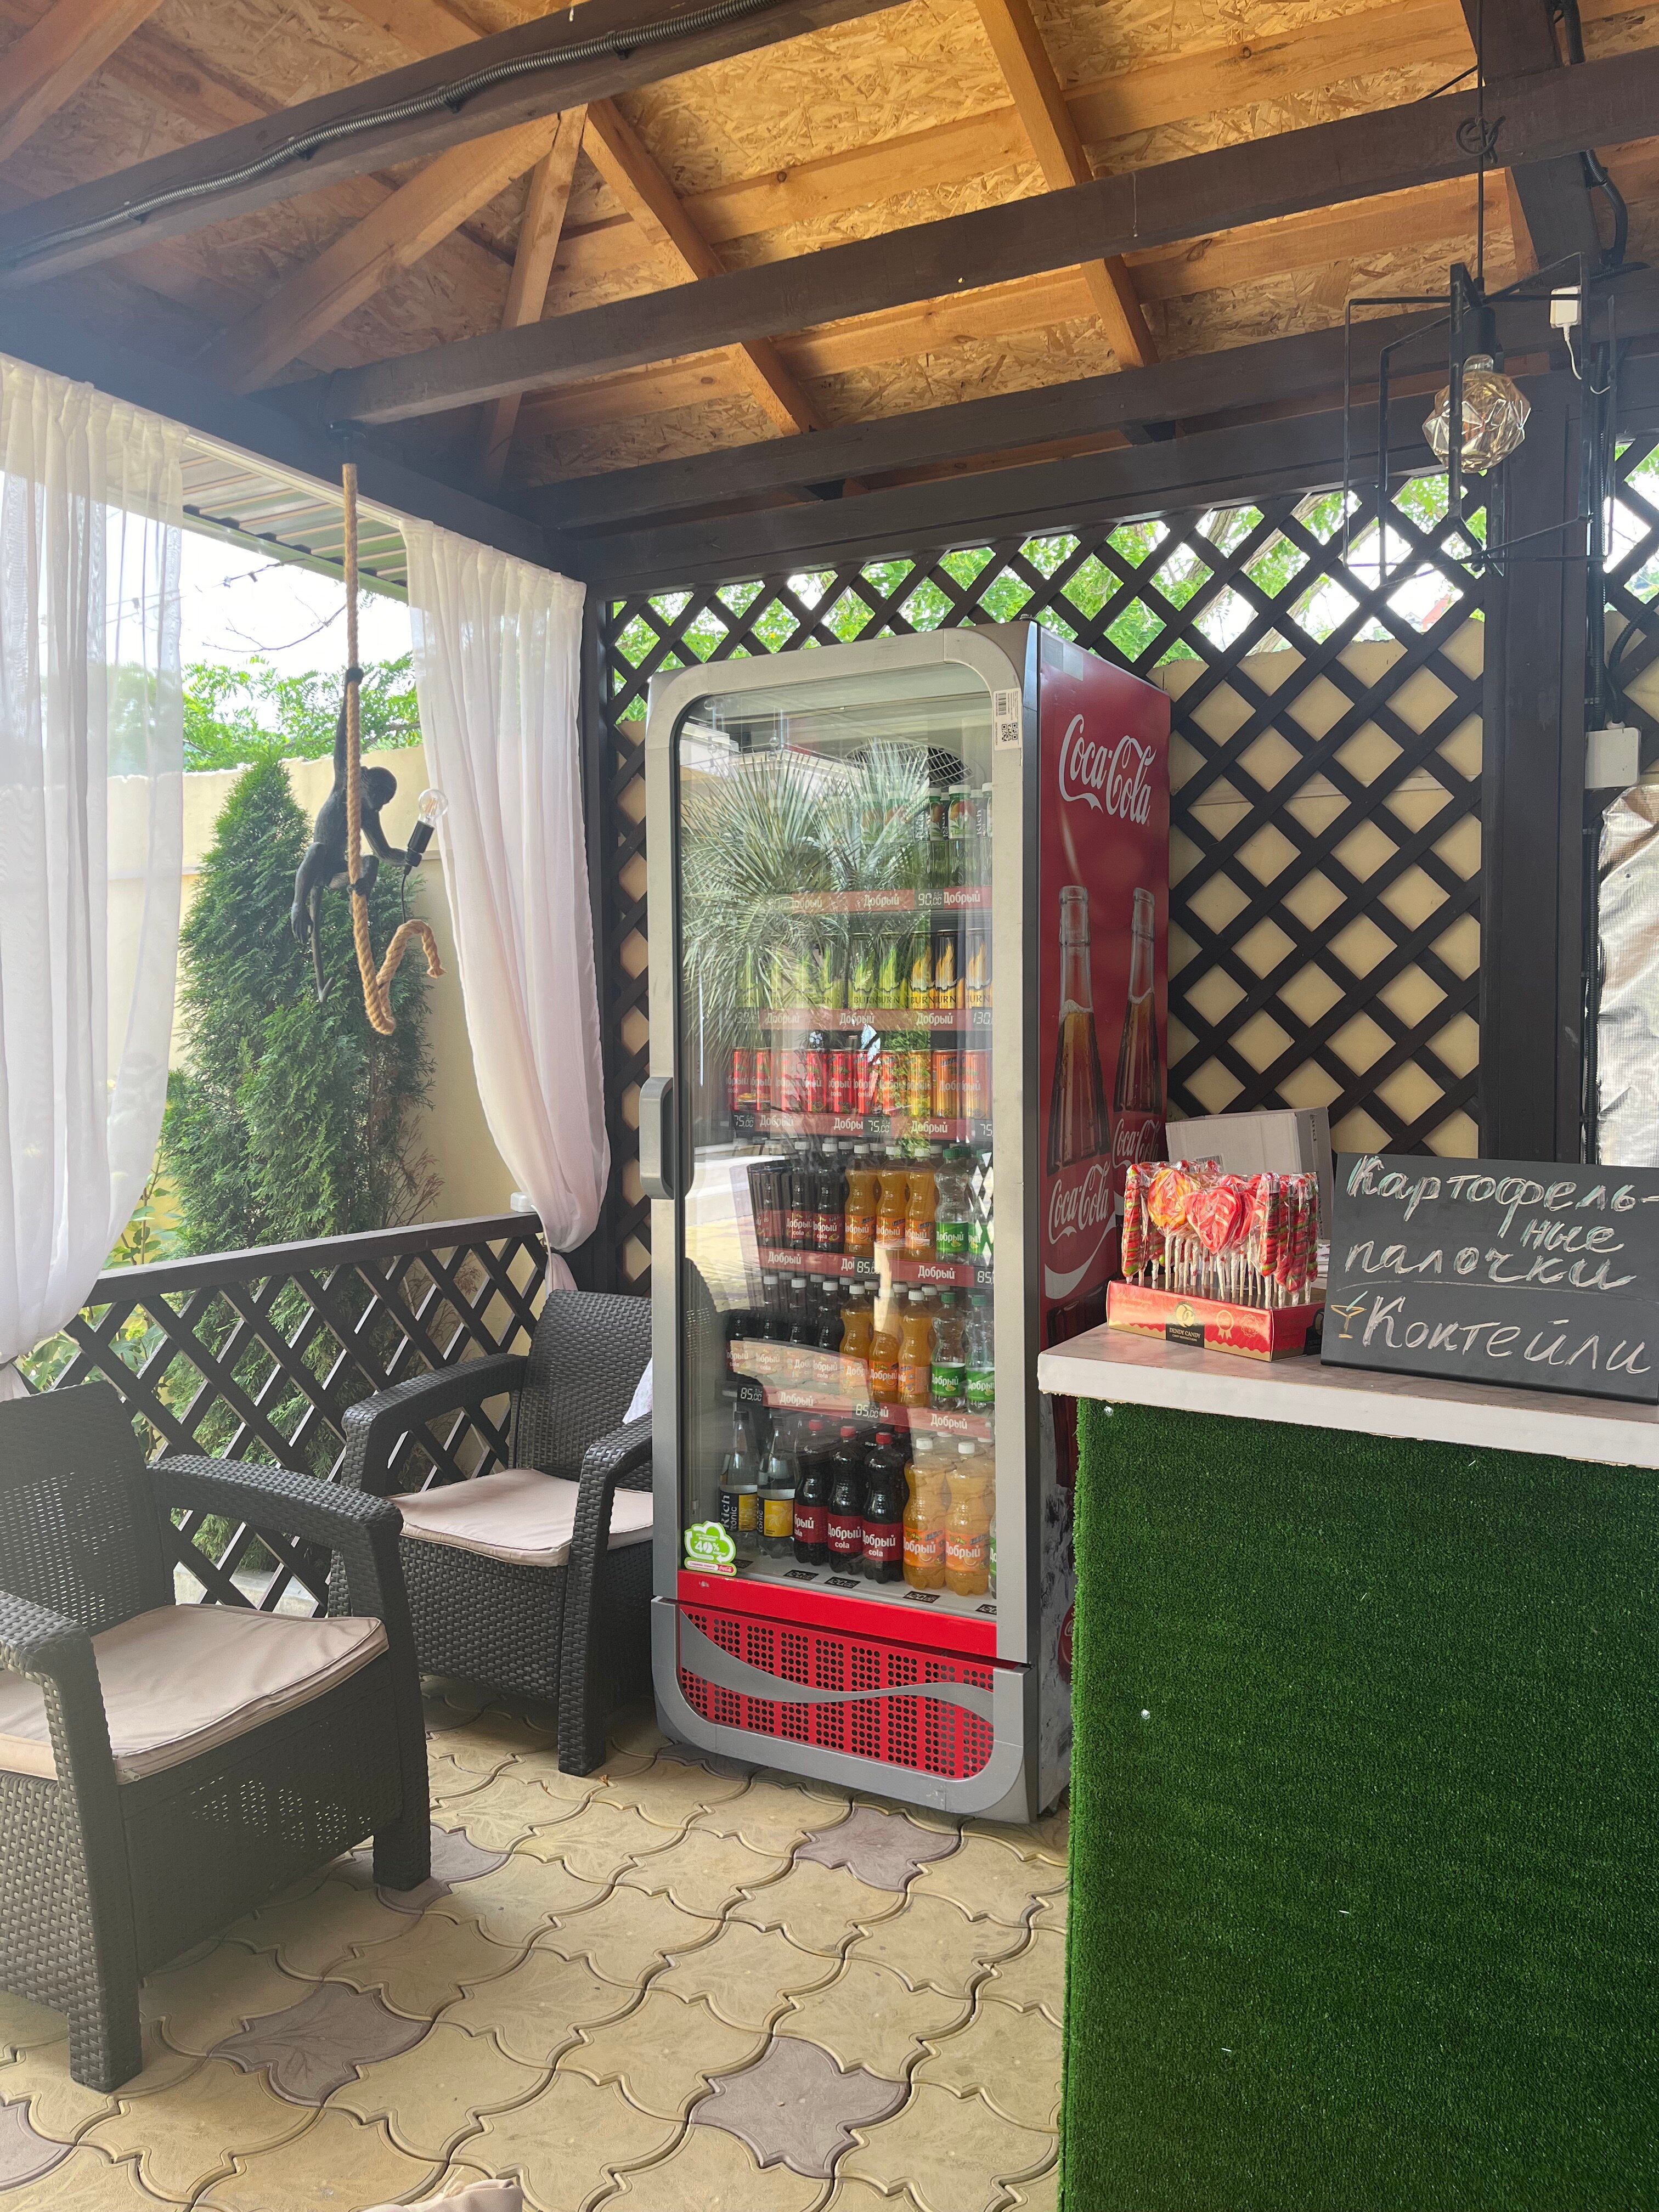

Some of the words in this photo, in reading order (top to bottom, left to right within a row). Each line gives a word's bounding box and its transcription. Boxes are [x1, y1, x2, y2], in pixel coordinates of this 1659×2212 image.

[863, 892, 900, 909] Добрый
[944, 890, 981, 906] Добрый
[911, 996, 934, 1004] BURN
[935, 995, 956, 1003] URN
[766, 1012, 800, 1024] Добрый
[839, 1011, 874, 1026] Добрый
[916, 1012, 953, 1026] Добрый
[760, 1114, 794, 1128] Добрый
[833, 1117, 864, 1132] Добры
[911, 1120, 948, 1134] Добрый
[936, 1231, 964, 1243] Добрый
[768, 1251, 802, 1265] Добрый
[1345, 1240, 1637, 1290] палочки
[917, 1265, 956, 1280] Добрый
[1169, 1327, 1184, 1335] DENDY
[1185, 1330, 1201, 1339] CANDY
[1363, 1295, 1651, 1374] Коктейли
[741, 1387, 762, 1402] 85,00
[779, 1391, 814, 1407] Добрый
[930, 1413, 968, 1430] Добрый
[827, 1522, 862, 1540] Добрый
[834, 1541, 850, 1549] cola
[868, 1548, 883, 1558] cola
